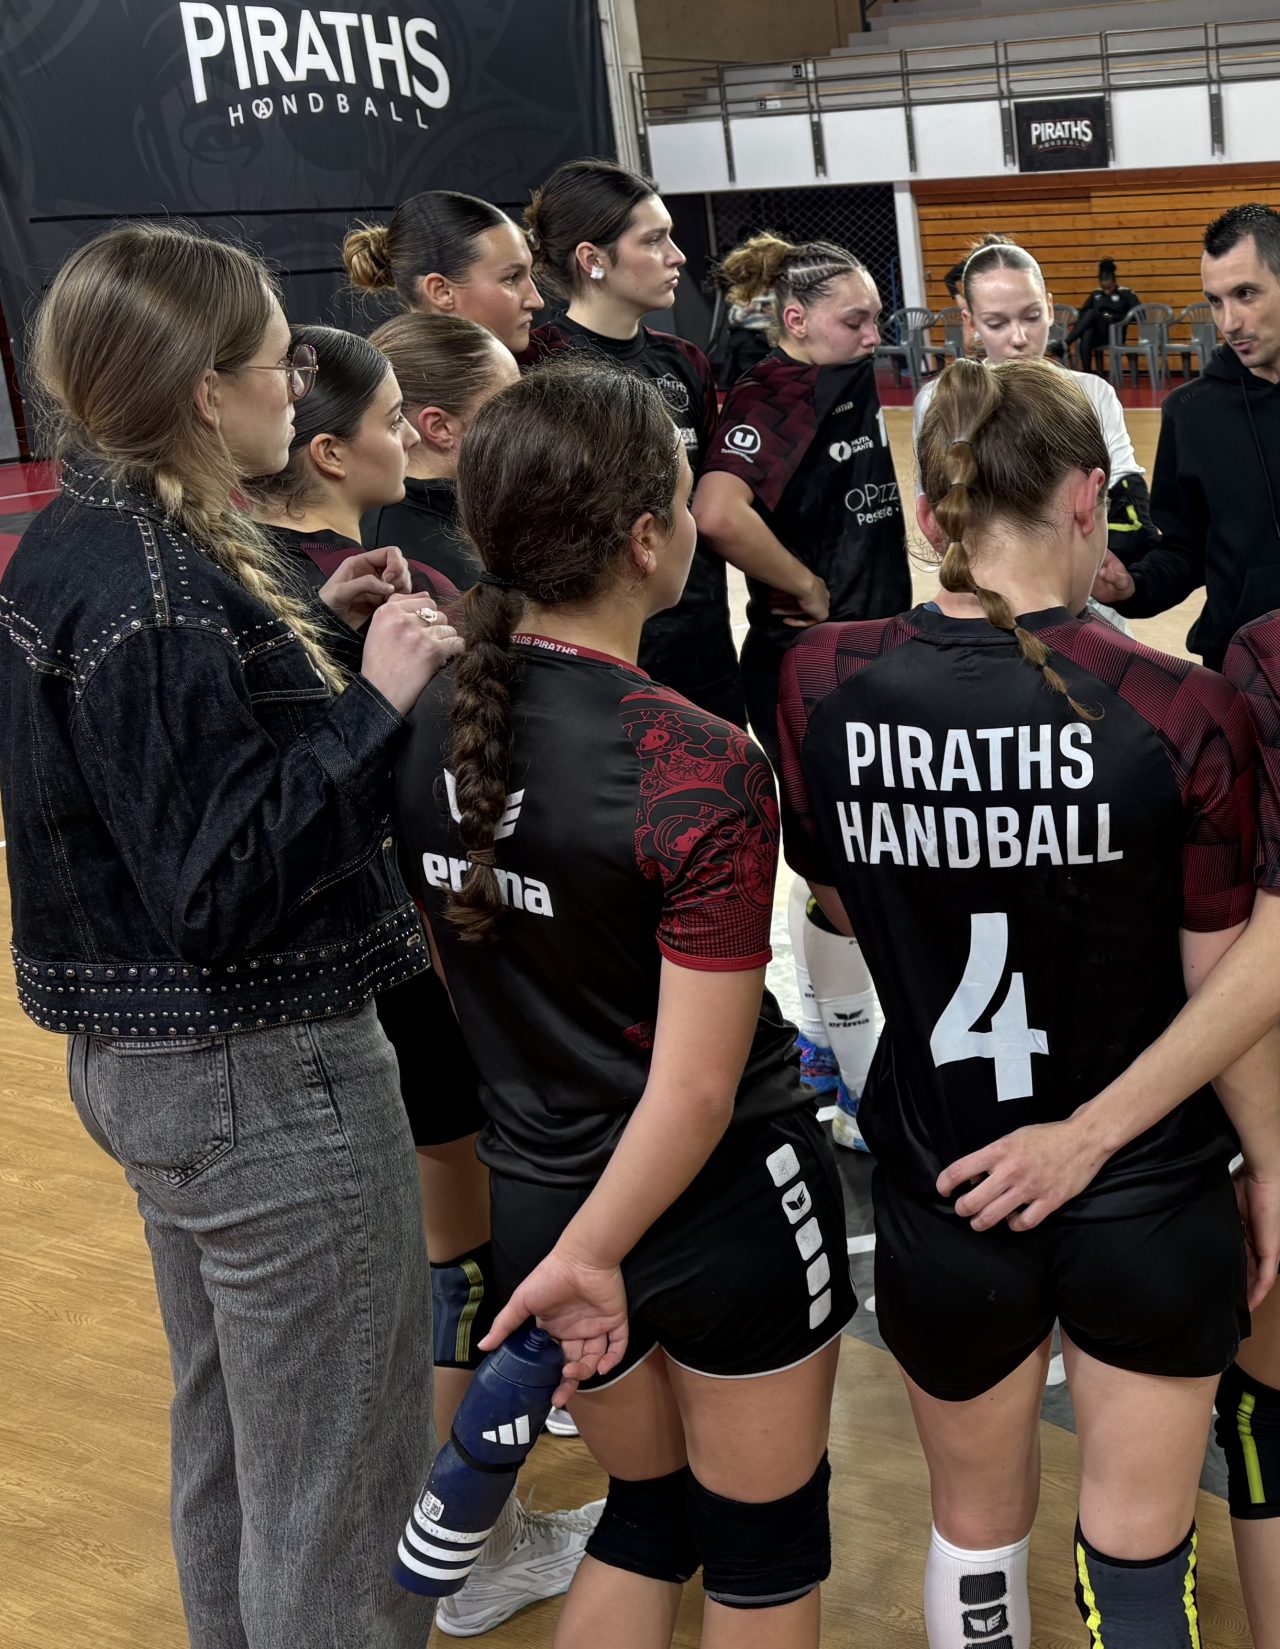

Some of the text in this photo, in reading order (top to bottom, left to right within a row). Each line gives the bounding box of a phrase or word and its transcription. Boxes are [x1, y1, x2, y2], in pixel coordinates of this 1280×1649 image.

[180, 2, 450, 109] PIRATHS
[228, 92, 428, 129] HANDBALL
[1031, 120, 1093, 145] PIRATHS
[516, 635, 532, 646] LOS
[533, 638, 578, 656] PIRATHS
[845, 721, 1094, 792] PIRATHS
[836, 801, 1123, 869] HANDBALL
[422, 852, 554, 917] erma
[829, 1018, 869, 1028] erima
[930, 912, 1050, 1102] 4
